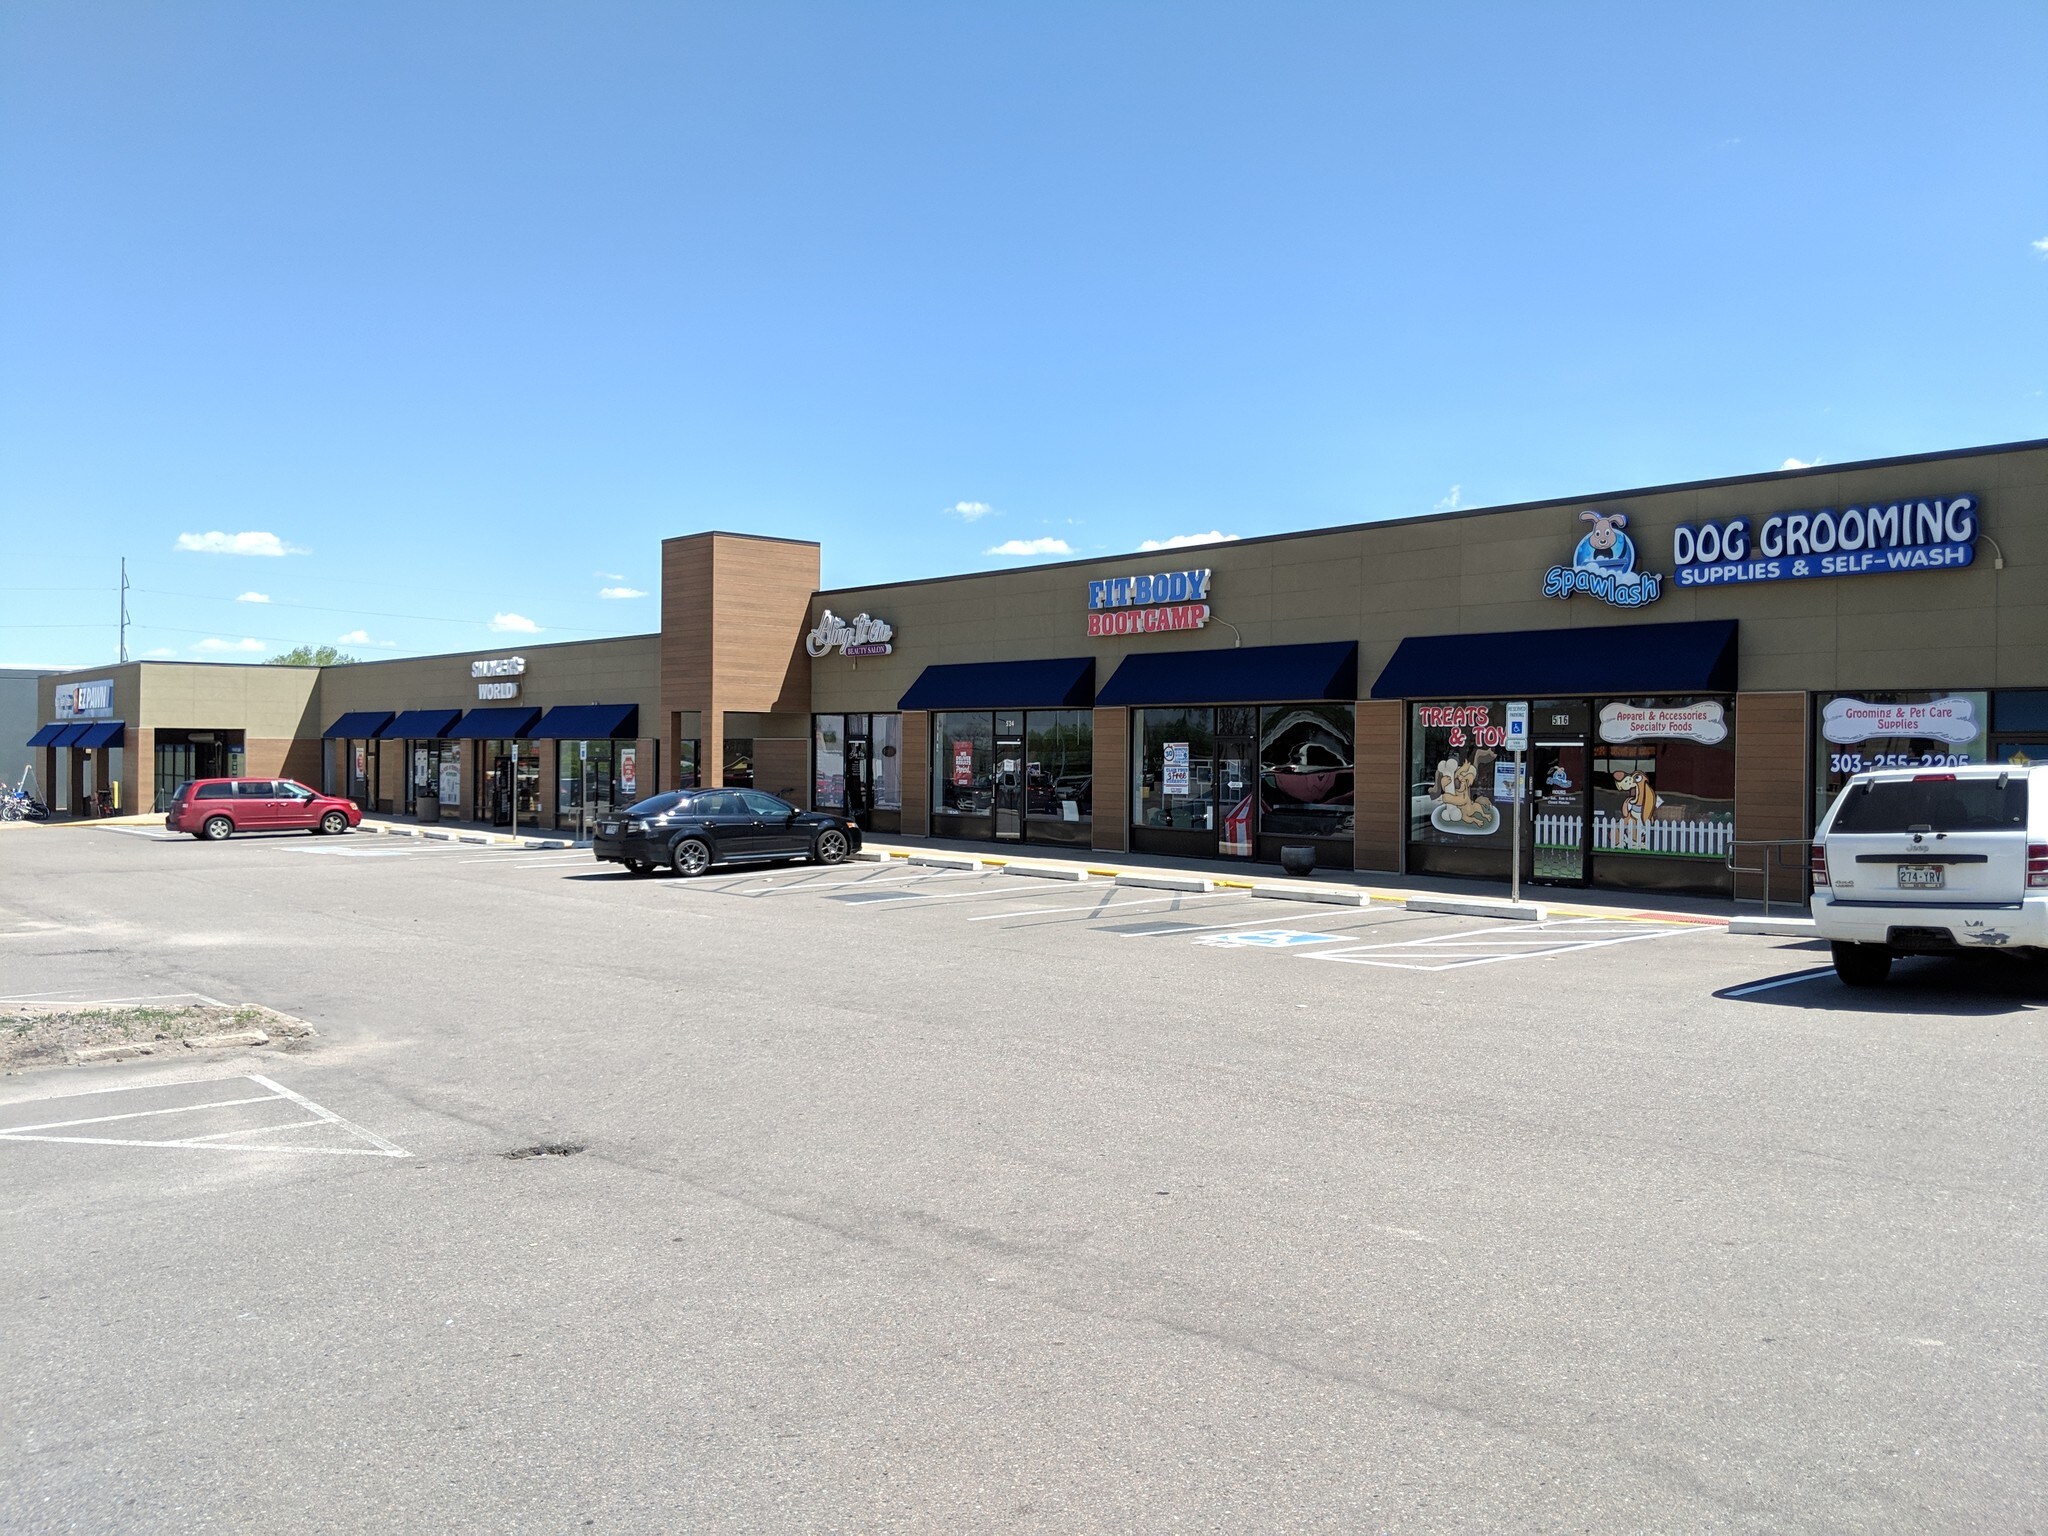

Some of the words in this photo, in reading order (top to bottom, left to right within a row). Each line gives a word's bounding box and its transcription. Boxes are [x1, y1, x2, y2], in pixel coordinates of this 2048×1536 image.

[1673, 520, 1746, 565] DOG
[1759, 497, 1974, 558] GROOMING
[1680, 561, 1781, 585] SUPPLIES
[1791, 559, 1810, 577] &
[1820, 546, 1965, 575] SELF-WASH
[1089, 577, 1133, 610] FIT
[1133, 569, 1210, 606] BODY
[1543, 566, 1661, 607] Spawlash
[1087, 609, 1143, 637] BOOT
[1143, 604, 1210, 633] CAMP
[847, 647, 867, 655] BEAUTY
[867, 645, 885, 654] SALON
[478, 682, 517, 700] WORLD
[1419, 706, 1489, 727] TREATS
[1552, 714, 1569, 726] 516
[1616, 711, 1646, 721] Apparel
[1648, 711, 1656, 721] &
[1658, 710, 1707, 721] Accessories
[1845, 708, 1892, 719] Grooming
[1895, 707, 1906, 718] &
[1909, 707, 1926, 718] Pet
[1929, 707, 1953, 718] Care
[1630, 722, 1666, 732] Specialty
[1668, 721, 1693, 731] Foods
[1877, 719, 1919, 730] Supplies
[1449, 726, 1467, 747] &
[1472, 726, 1507, 747] TOY
[1906, 843, 1930, 852] Jeep
[1900, 871, 1941, 883] 274-YRV
